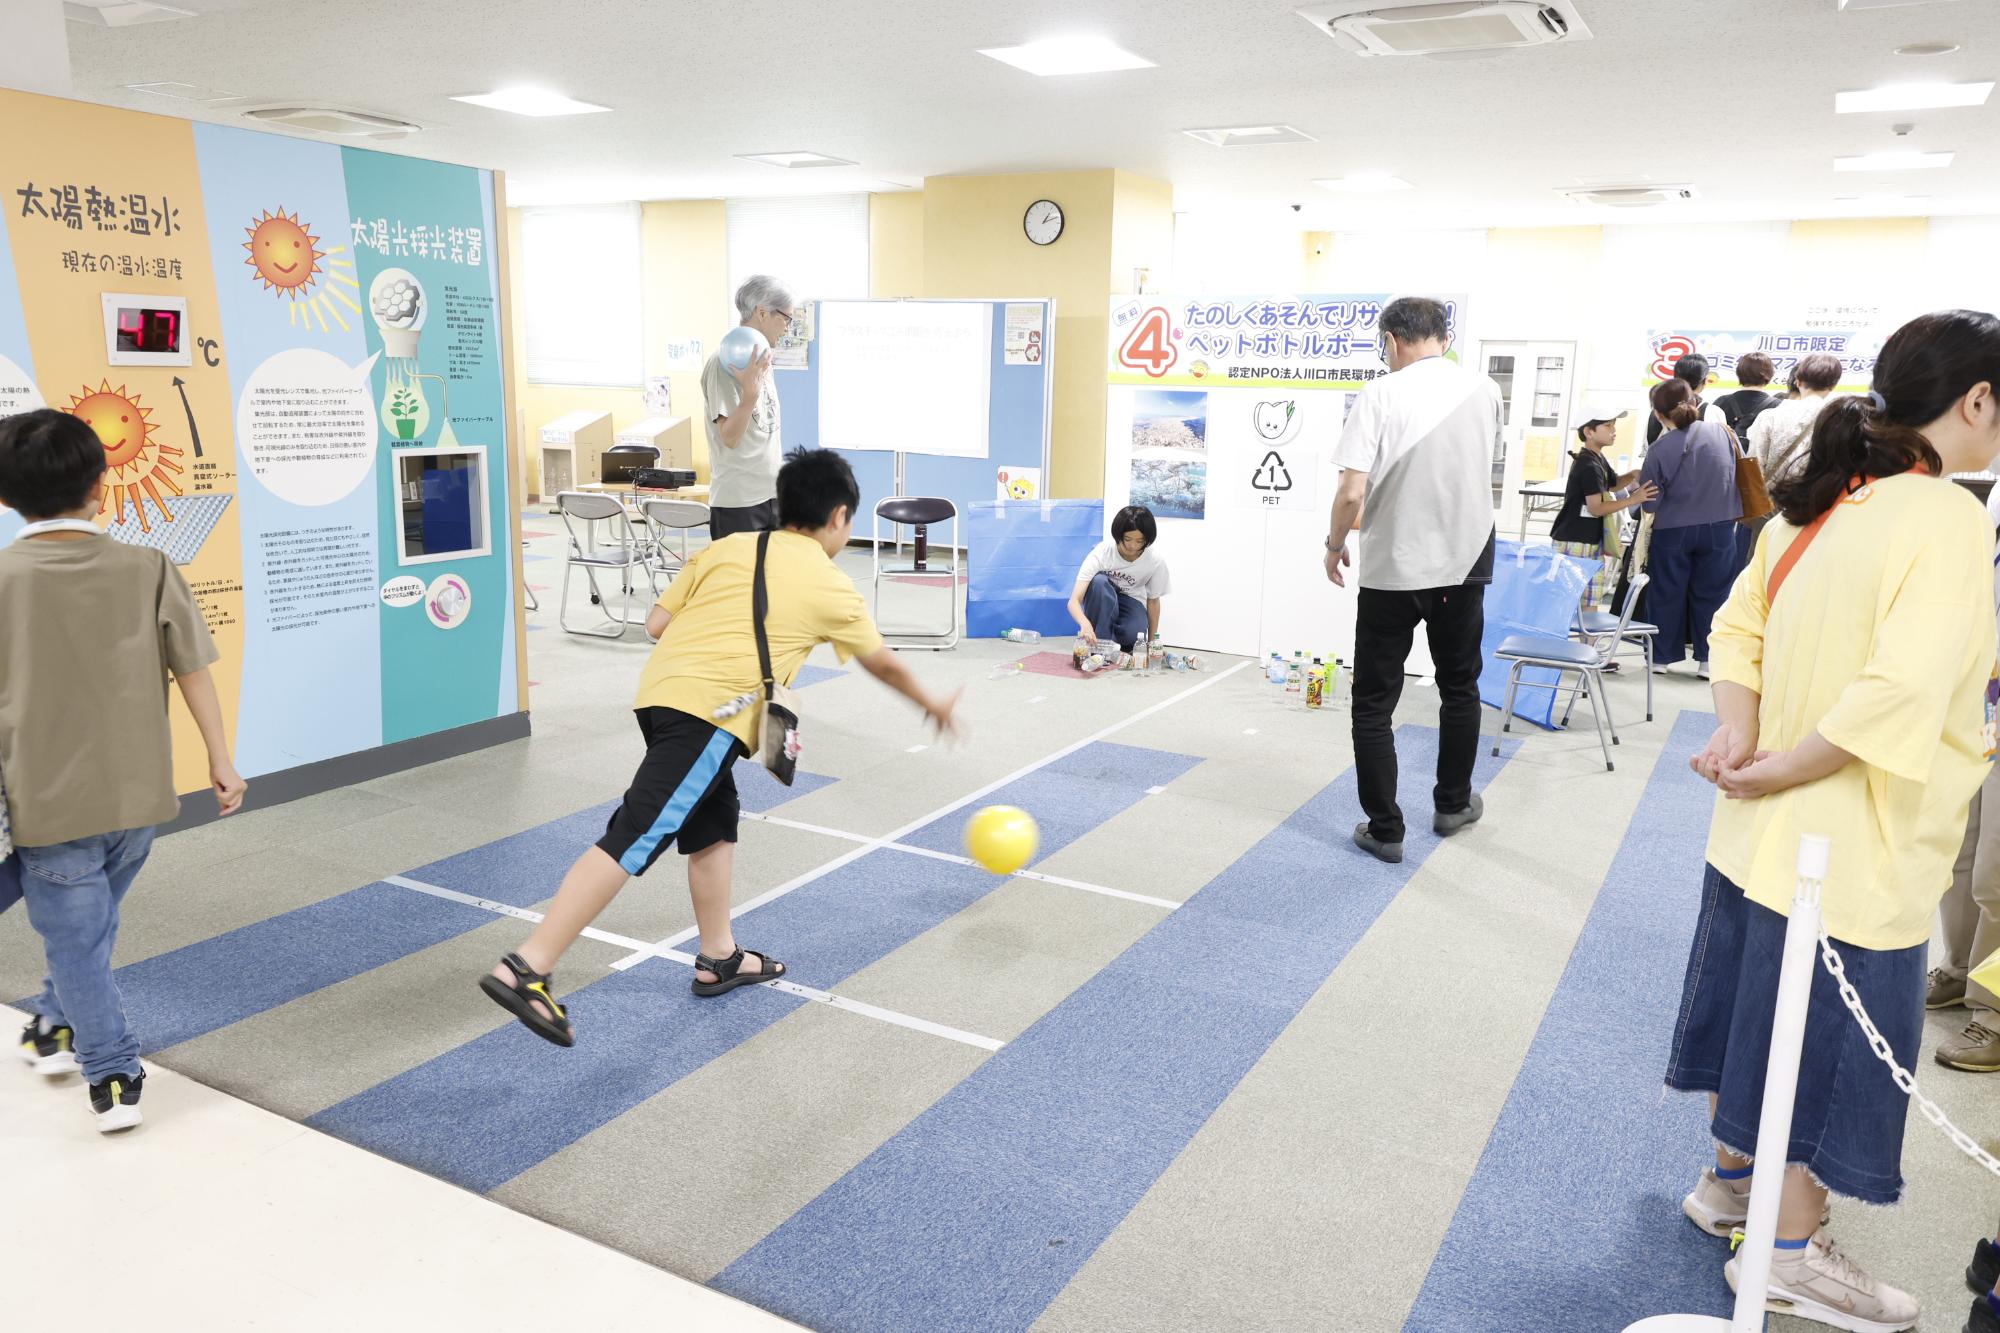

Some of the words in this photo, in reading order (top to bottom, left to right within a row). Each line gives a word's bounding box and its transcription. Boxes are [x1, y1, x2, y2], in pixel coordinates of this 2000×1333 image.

[16, 182, 181, 237] 太陽熱温水
[350, 216, 482, 266] 太陽光採光装置
[61, 250, 183, 280] 現在の温水温度
[120, 312, 176, 348] 47
[1122, 310, 1174, 374] 4
[1758, 336, 1846, 352] 川口市限定
[1262, 496, 1281, 505] PET
